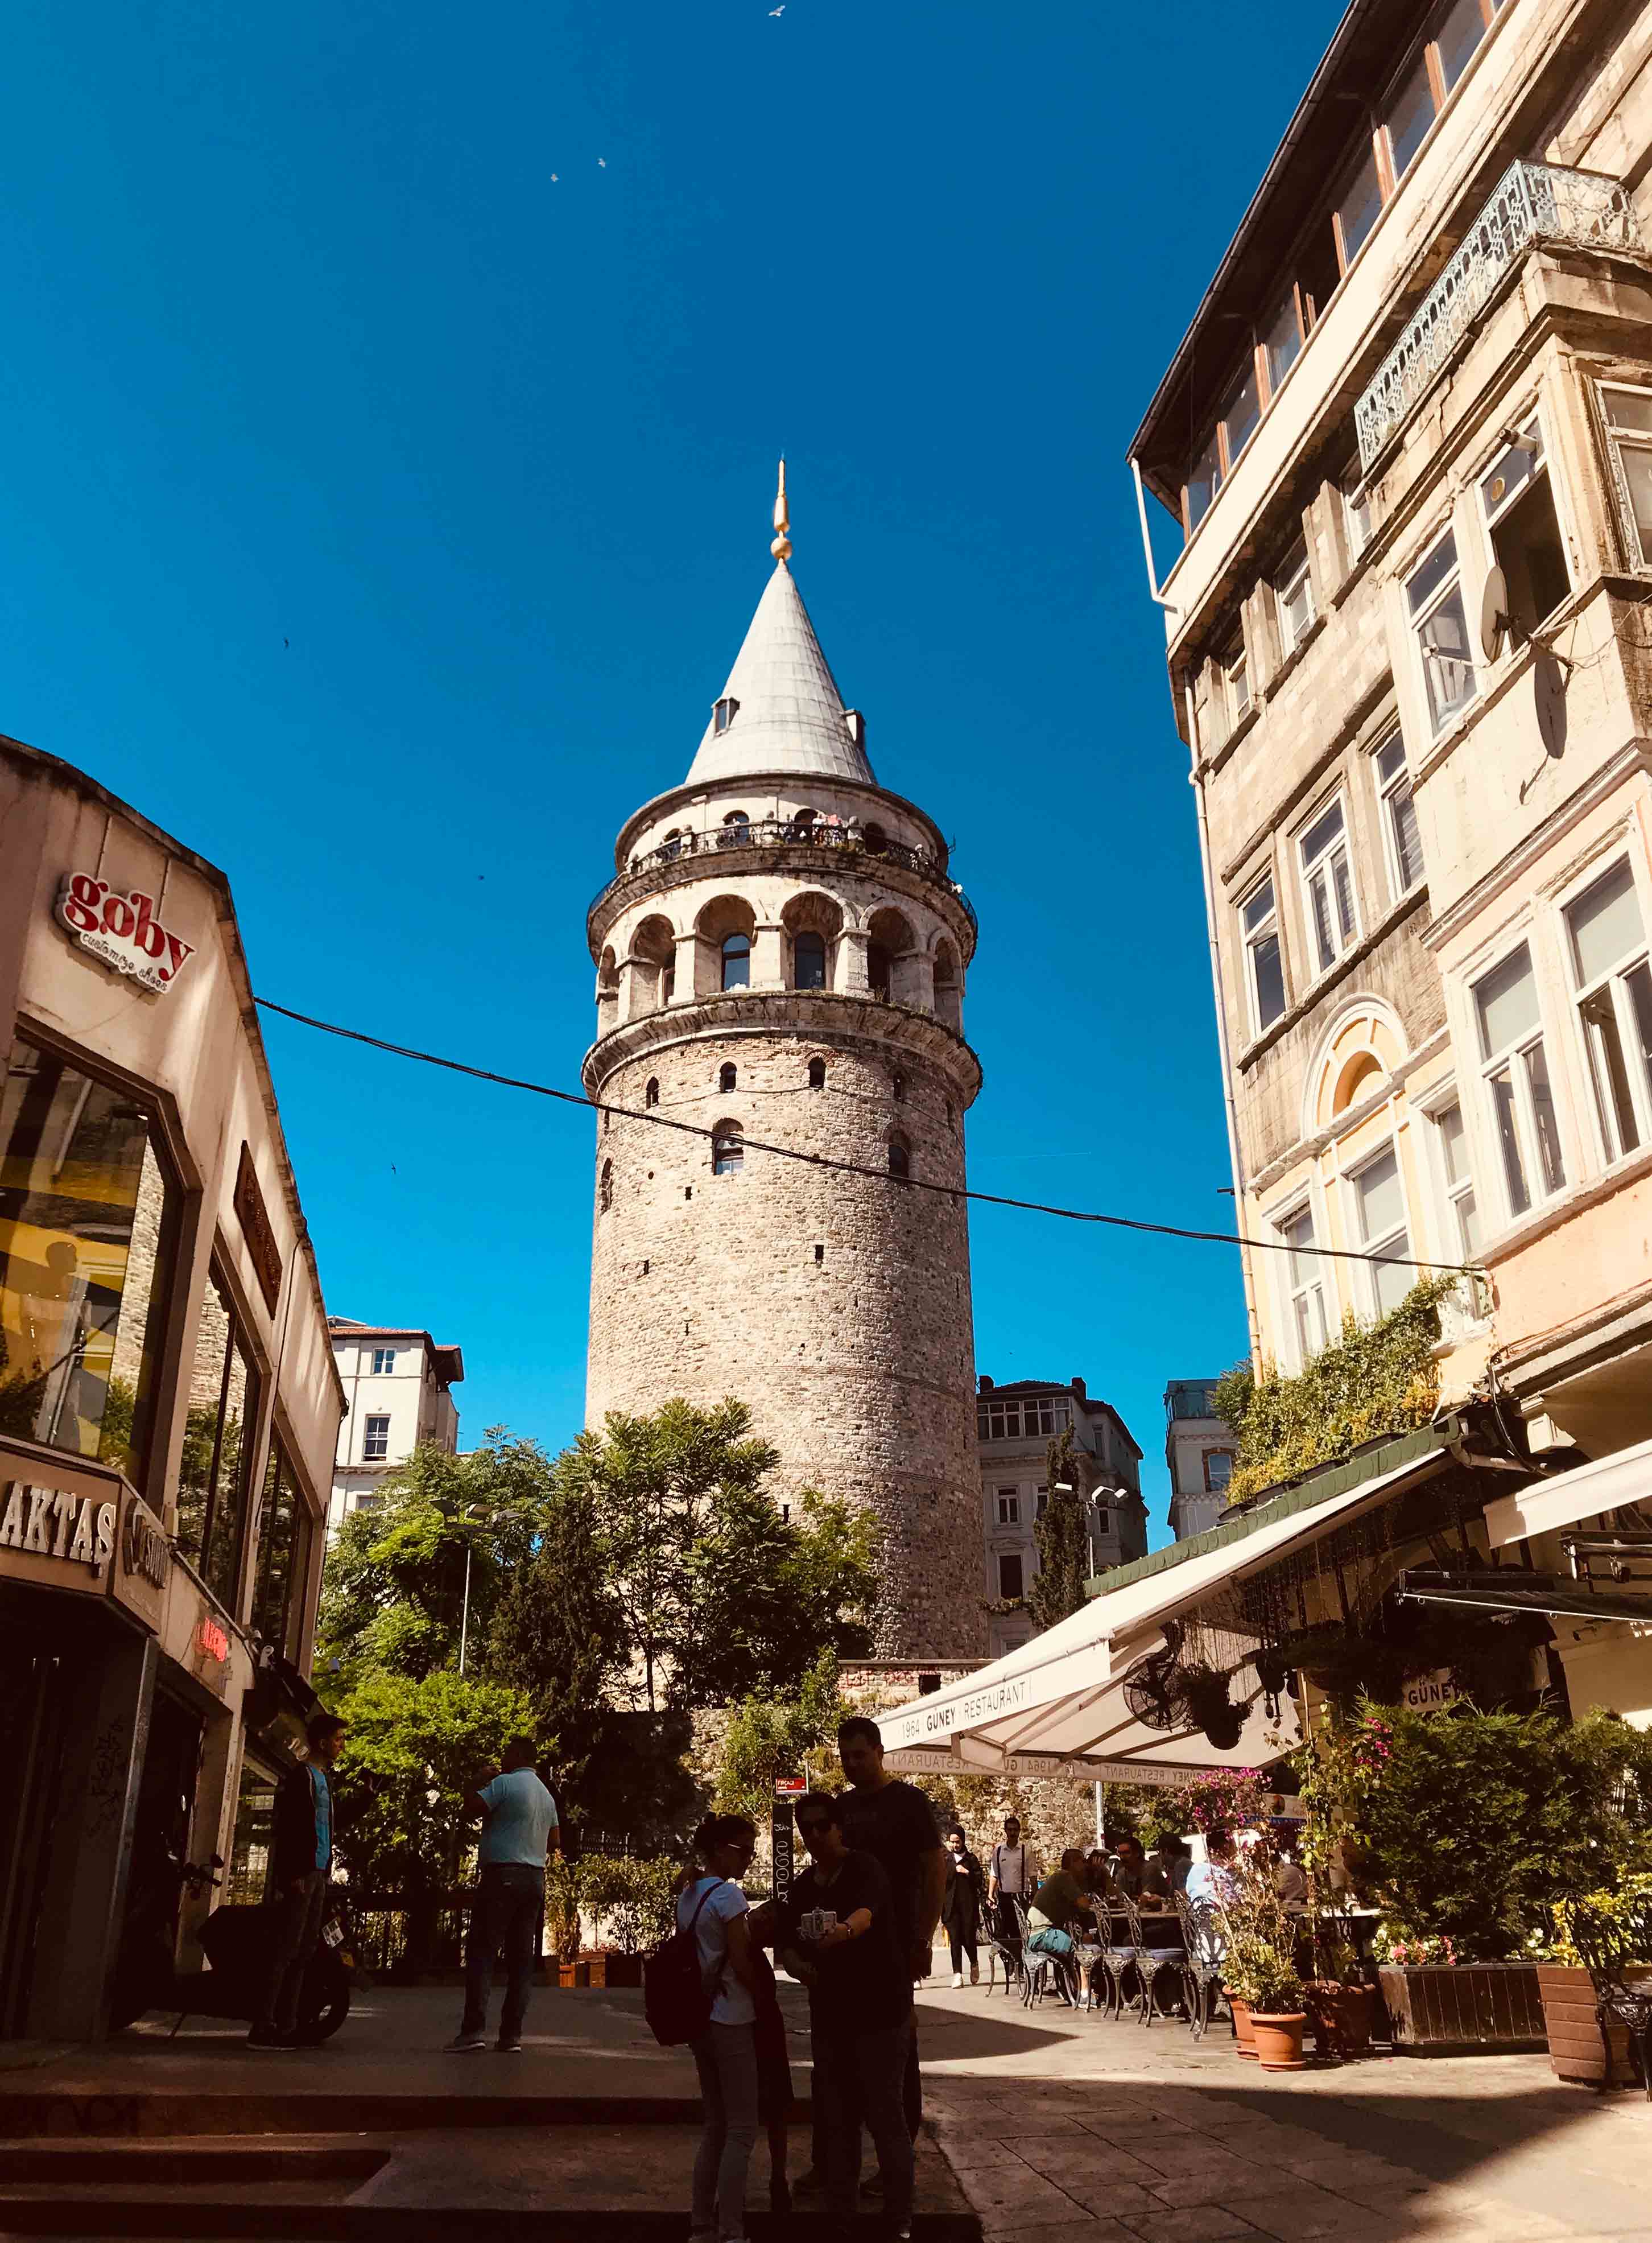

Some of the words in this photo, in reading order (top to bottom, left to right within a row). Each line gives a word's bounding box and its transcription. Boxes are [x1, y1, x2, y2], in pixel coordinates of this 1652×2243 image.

[82, 933, 135, 970] customize
[138, 967, 167, 991] shoes
[902, 1718, 920, 1739] 1964
[964, 1681, 1025, 1721] RESTAURANT
